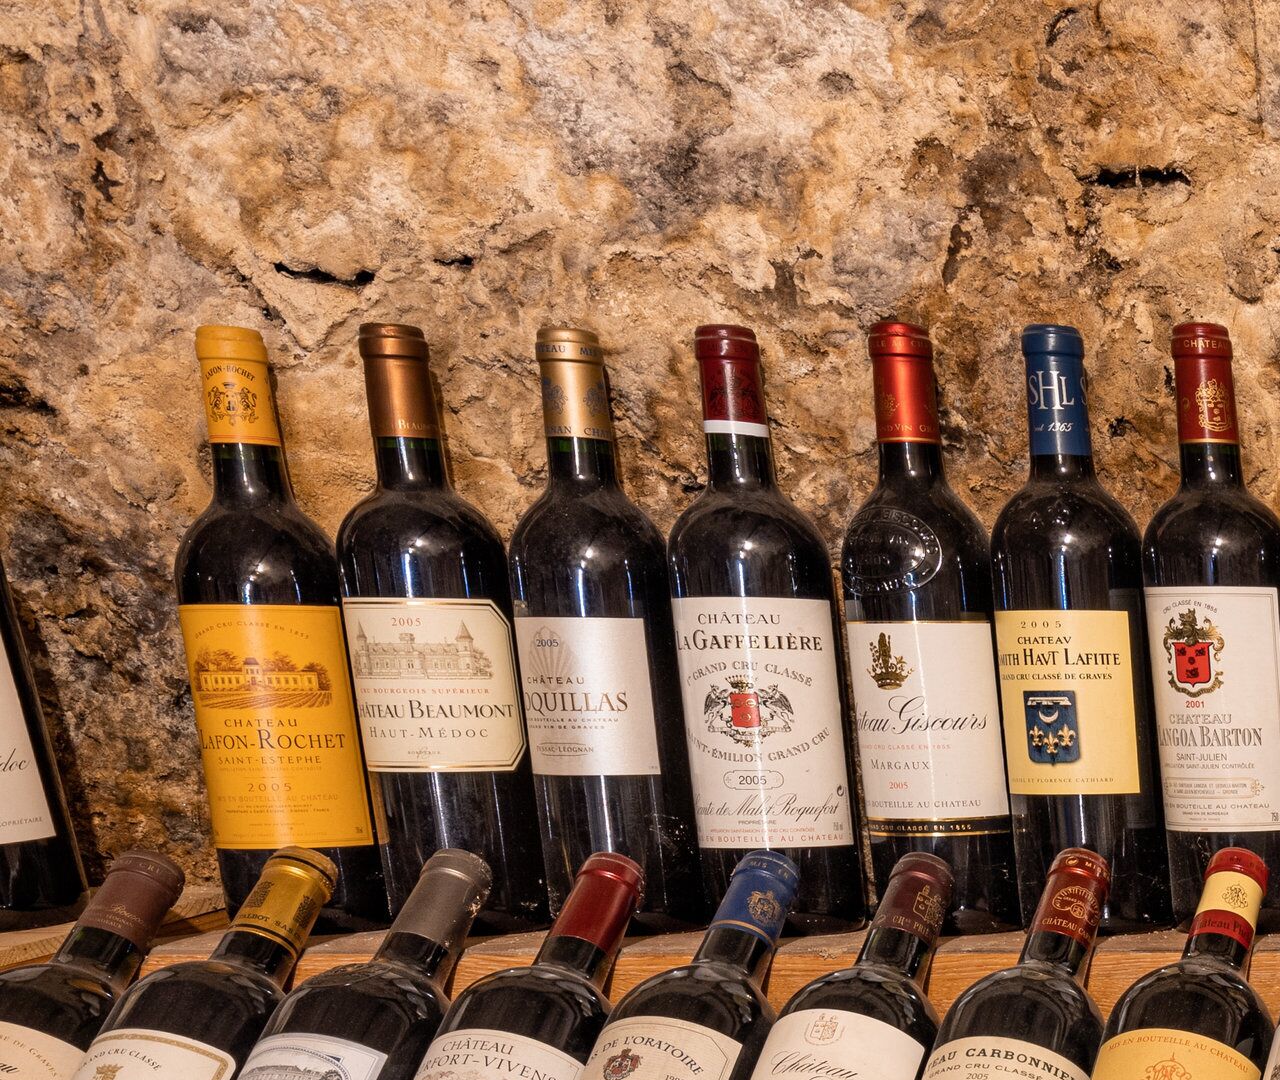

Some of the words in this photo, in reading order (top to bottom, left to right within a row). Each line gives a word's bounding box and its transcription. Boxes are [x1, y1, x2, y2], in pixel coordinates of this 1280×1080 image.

[1029, 371, 1074, 410] SHL
[1047, 422, 1073, 433] 1365
[391, 617, 421, 627] 2005
[698, 611, 781, 625] CHÂTEAU
[1021, 621, 1061, 629] 2005
[536, 638, 559, 647] 2005
[692, 630, 823, 651] GAFFELIÈRE
[1064, 649, 1120, 666] LAFITTE
[527, 674, 584, 685] CHÂTEAU
[409, 699, 514, 719] BEAUMONT
[889, 696, 988, 735] Giscours
[1169, 714, 1232, 724] CHATEAU
[224, 719, 298, 728] CHATEAU
[370, 727, 488, 738] HAUT-MÉDOC
[1201, 728, 1262, 747] BARTON
[201, 729, 346, 750] LAFON-ROCHET
[218, 755, 321, 764] SAINT-ESTEPHE
[1177, 753, 1227, 761] SAINT-JULIEN
[871, 759, 930, 770] MARGAUX
[738, 774, 767, 786] 2005
[248, 783, 292, 792] 2005
[442, 1037, 514, 1055] CHÂTEAU
[602, 1040, 620, 1054] DE
[624, 1036, 704, 1076] L'ORATOIRE
[771, 1051, 860, 1080] Château
[966, 1072, 988, 1080] 2005
